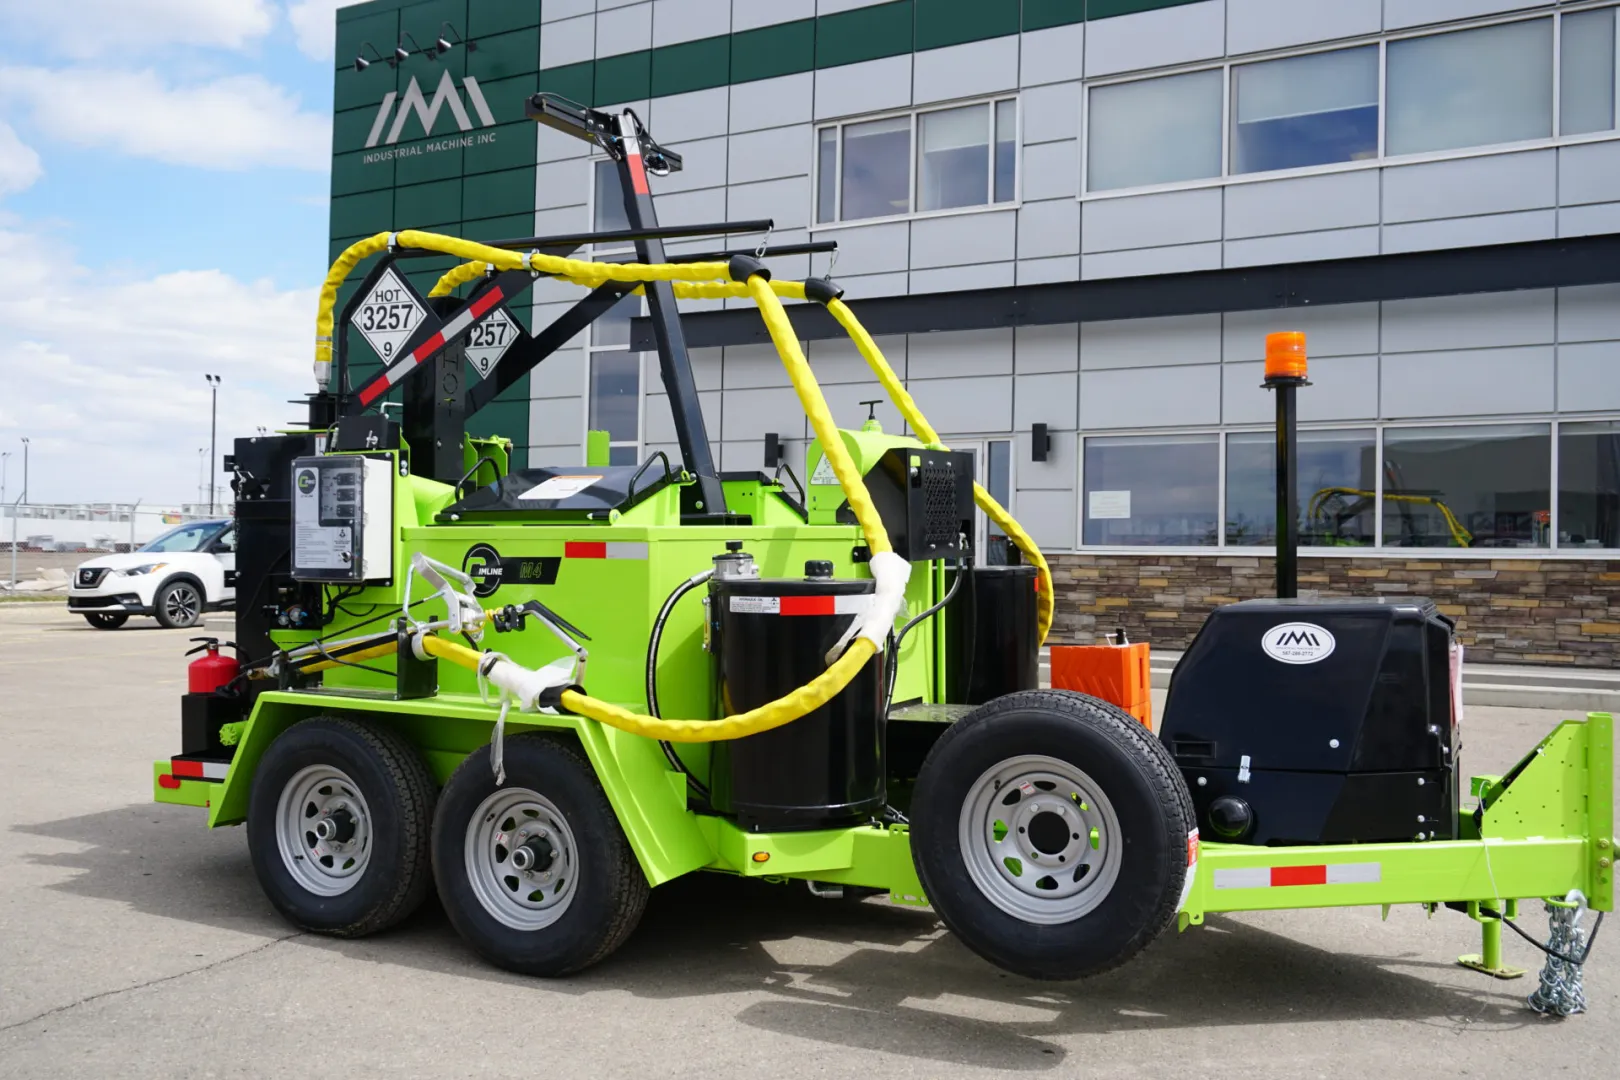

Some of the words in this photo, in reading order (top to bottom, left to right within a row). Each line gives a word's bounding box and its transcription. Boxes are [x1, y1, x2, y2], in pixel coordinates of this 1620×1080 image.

[363, 145, 423, 164] INDUSTRIAL
[426, 136, 473, 152] MACHINE
[477, 132, 496, 145] INC
[374, 288, 401, 303] HOT
[362, 304, 413, 332] 3257
[383, 341, 393, 358] 9
[480, 356, 489, 372] 9
[519, 561, 543, 579] M4
